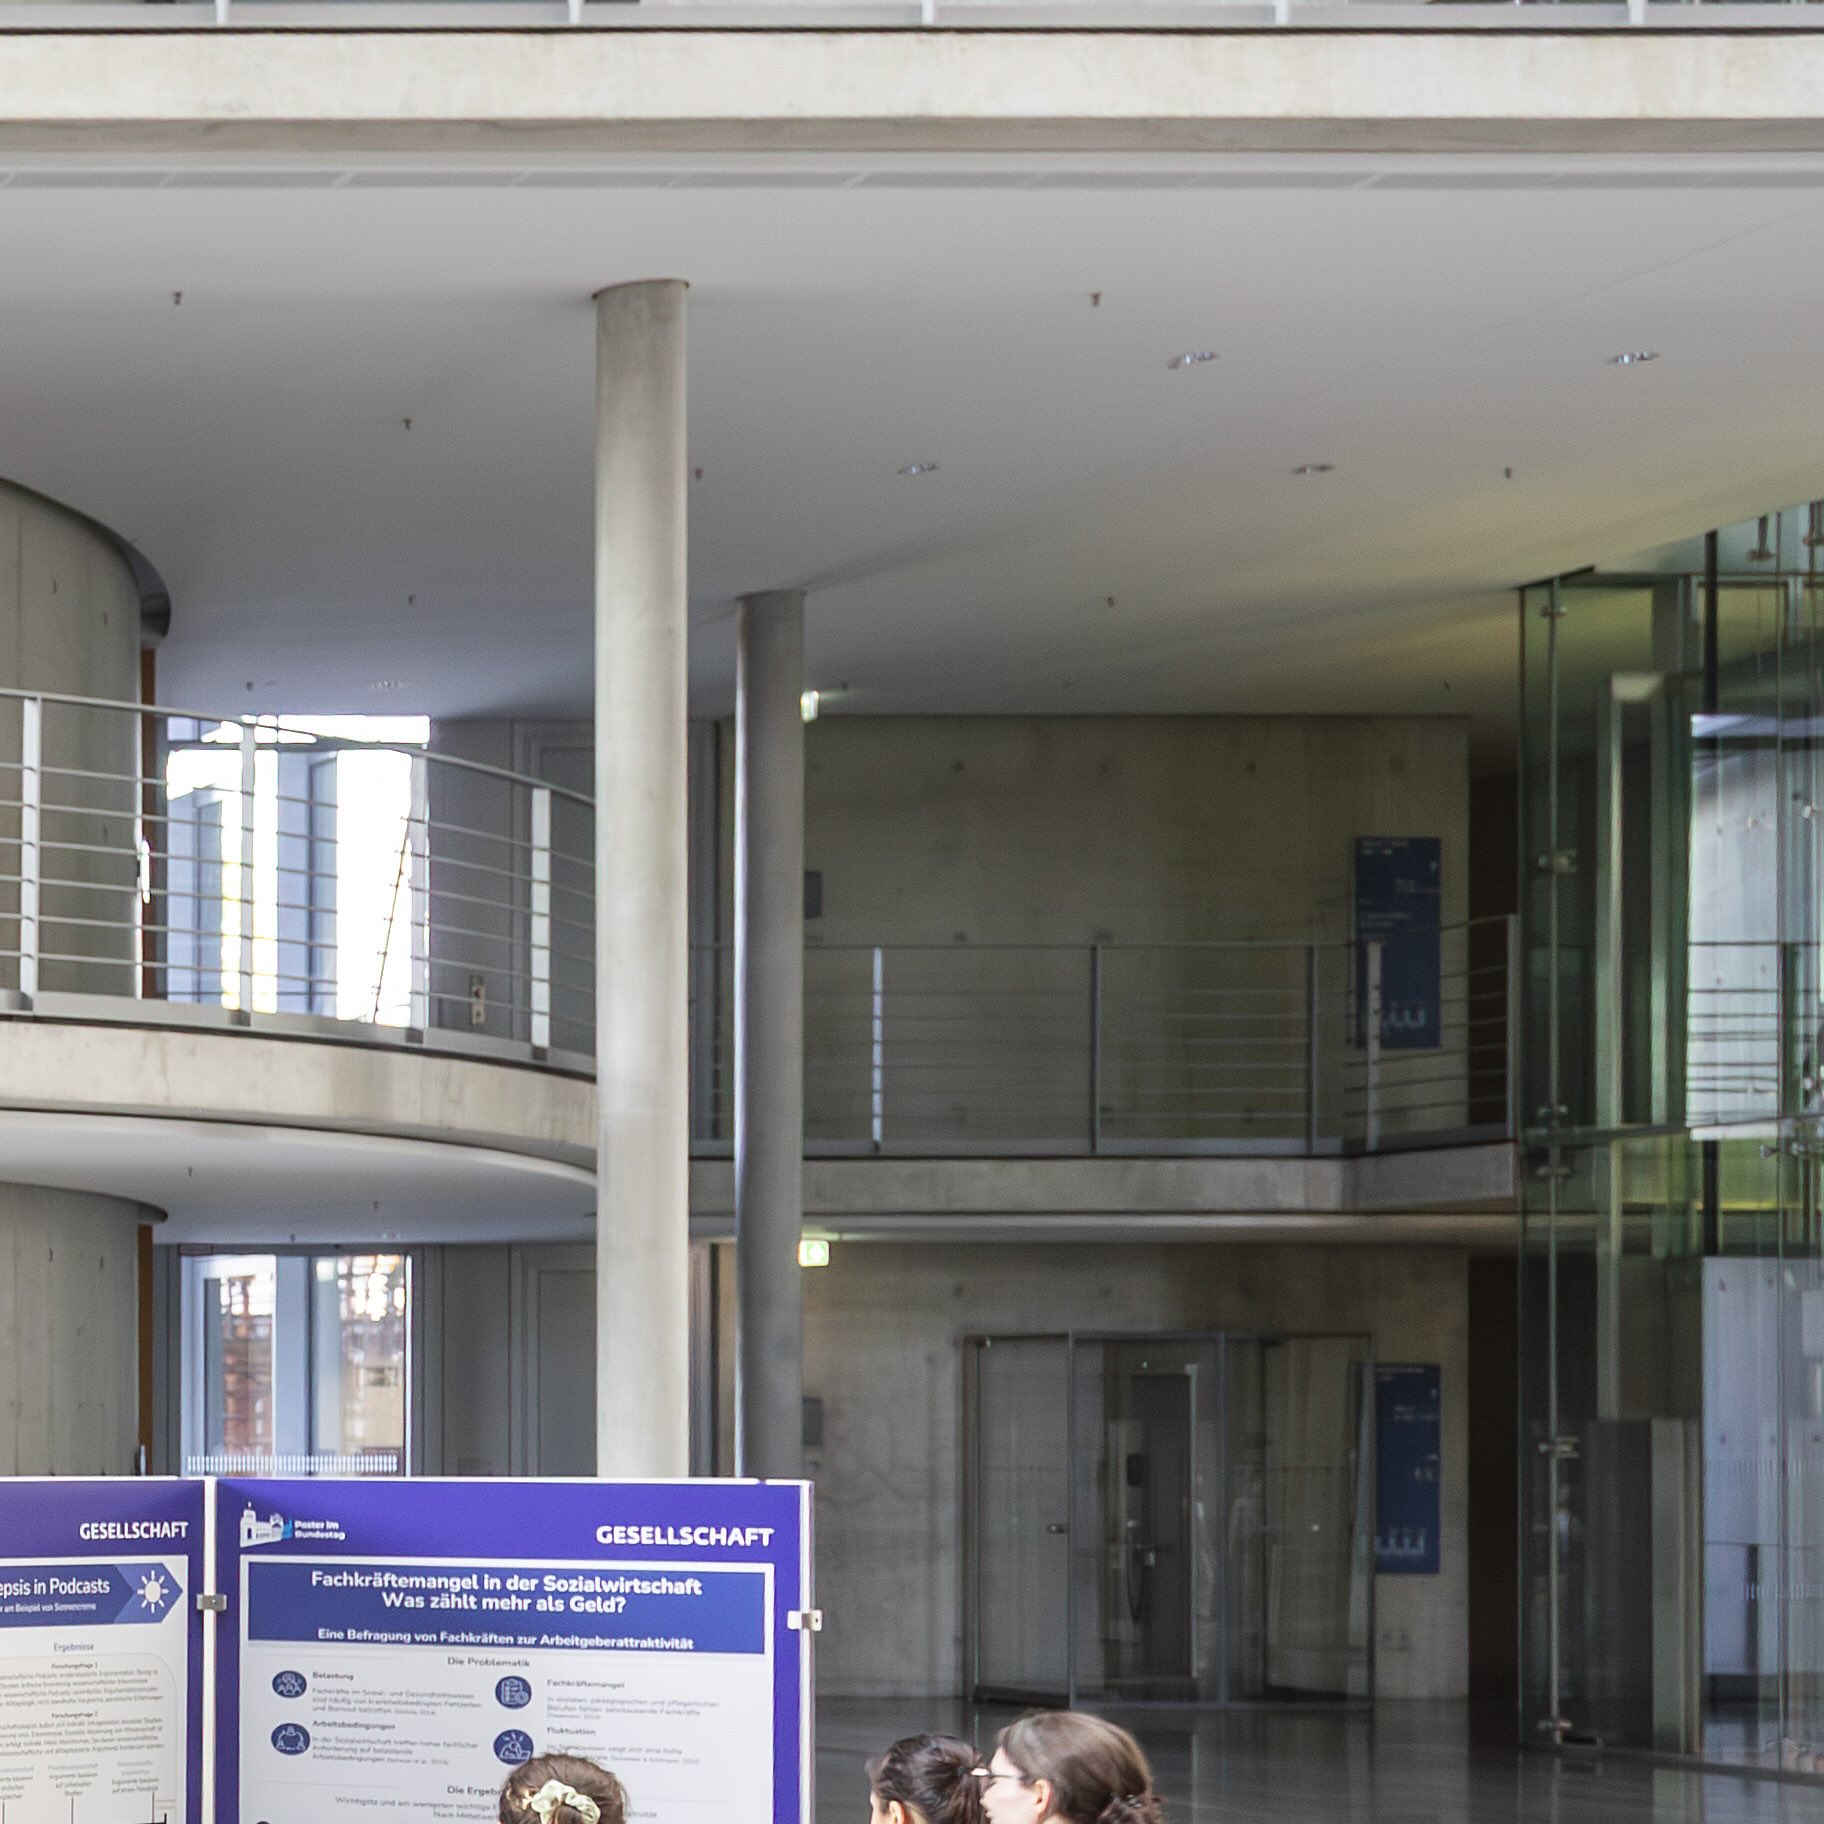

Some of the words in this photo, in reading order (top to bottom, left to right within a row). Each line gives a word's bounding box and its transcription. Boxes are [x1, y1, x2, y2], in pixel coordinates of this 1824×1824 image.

[79, 1521, 189, 1540] GESELLSCHAFT
[596, 1525, 774, 1546] GESELLSCHAFT
[33, 1578, 46, 1595] in
[49, 1577, 110, 1595] Podcasts
[311, 1571, 479, 1592] Fachkräftemangel
[483, 1573, 501, 1590] in
[505, 1574, 539, 1591] der
[542, 1574, 702, 1595] Sozialwirtschaft
[381, 1591, 424, 1608] Was
[430, 1592, 477, 1610] zählt
[481, 1593, 532, 1611] mehr
[535, 1594, 565, 1612] als
[569, 1595, 626, 1613] Geld?
[318, 1628, 345, 1640] Eine
[347, 1629, 412, 1644] Befragung
[414, 1633, 437, 1643] von
[439, 1631, 515, 1645] Fachkräften
[517, 1635, 538, 1646] zur
[539, 1634, 695, 1651] Arbeitgeberattraktivität
